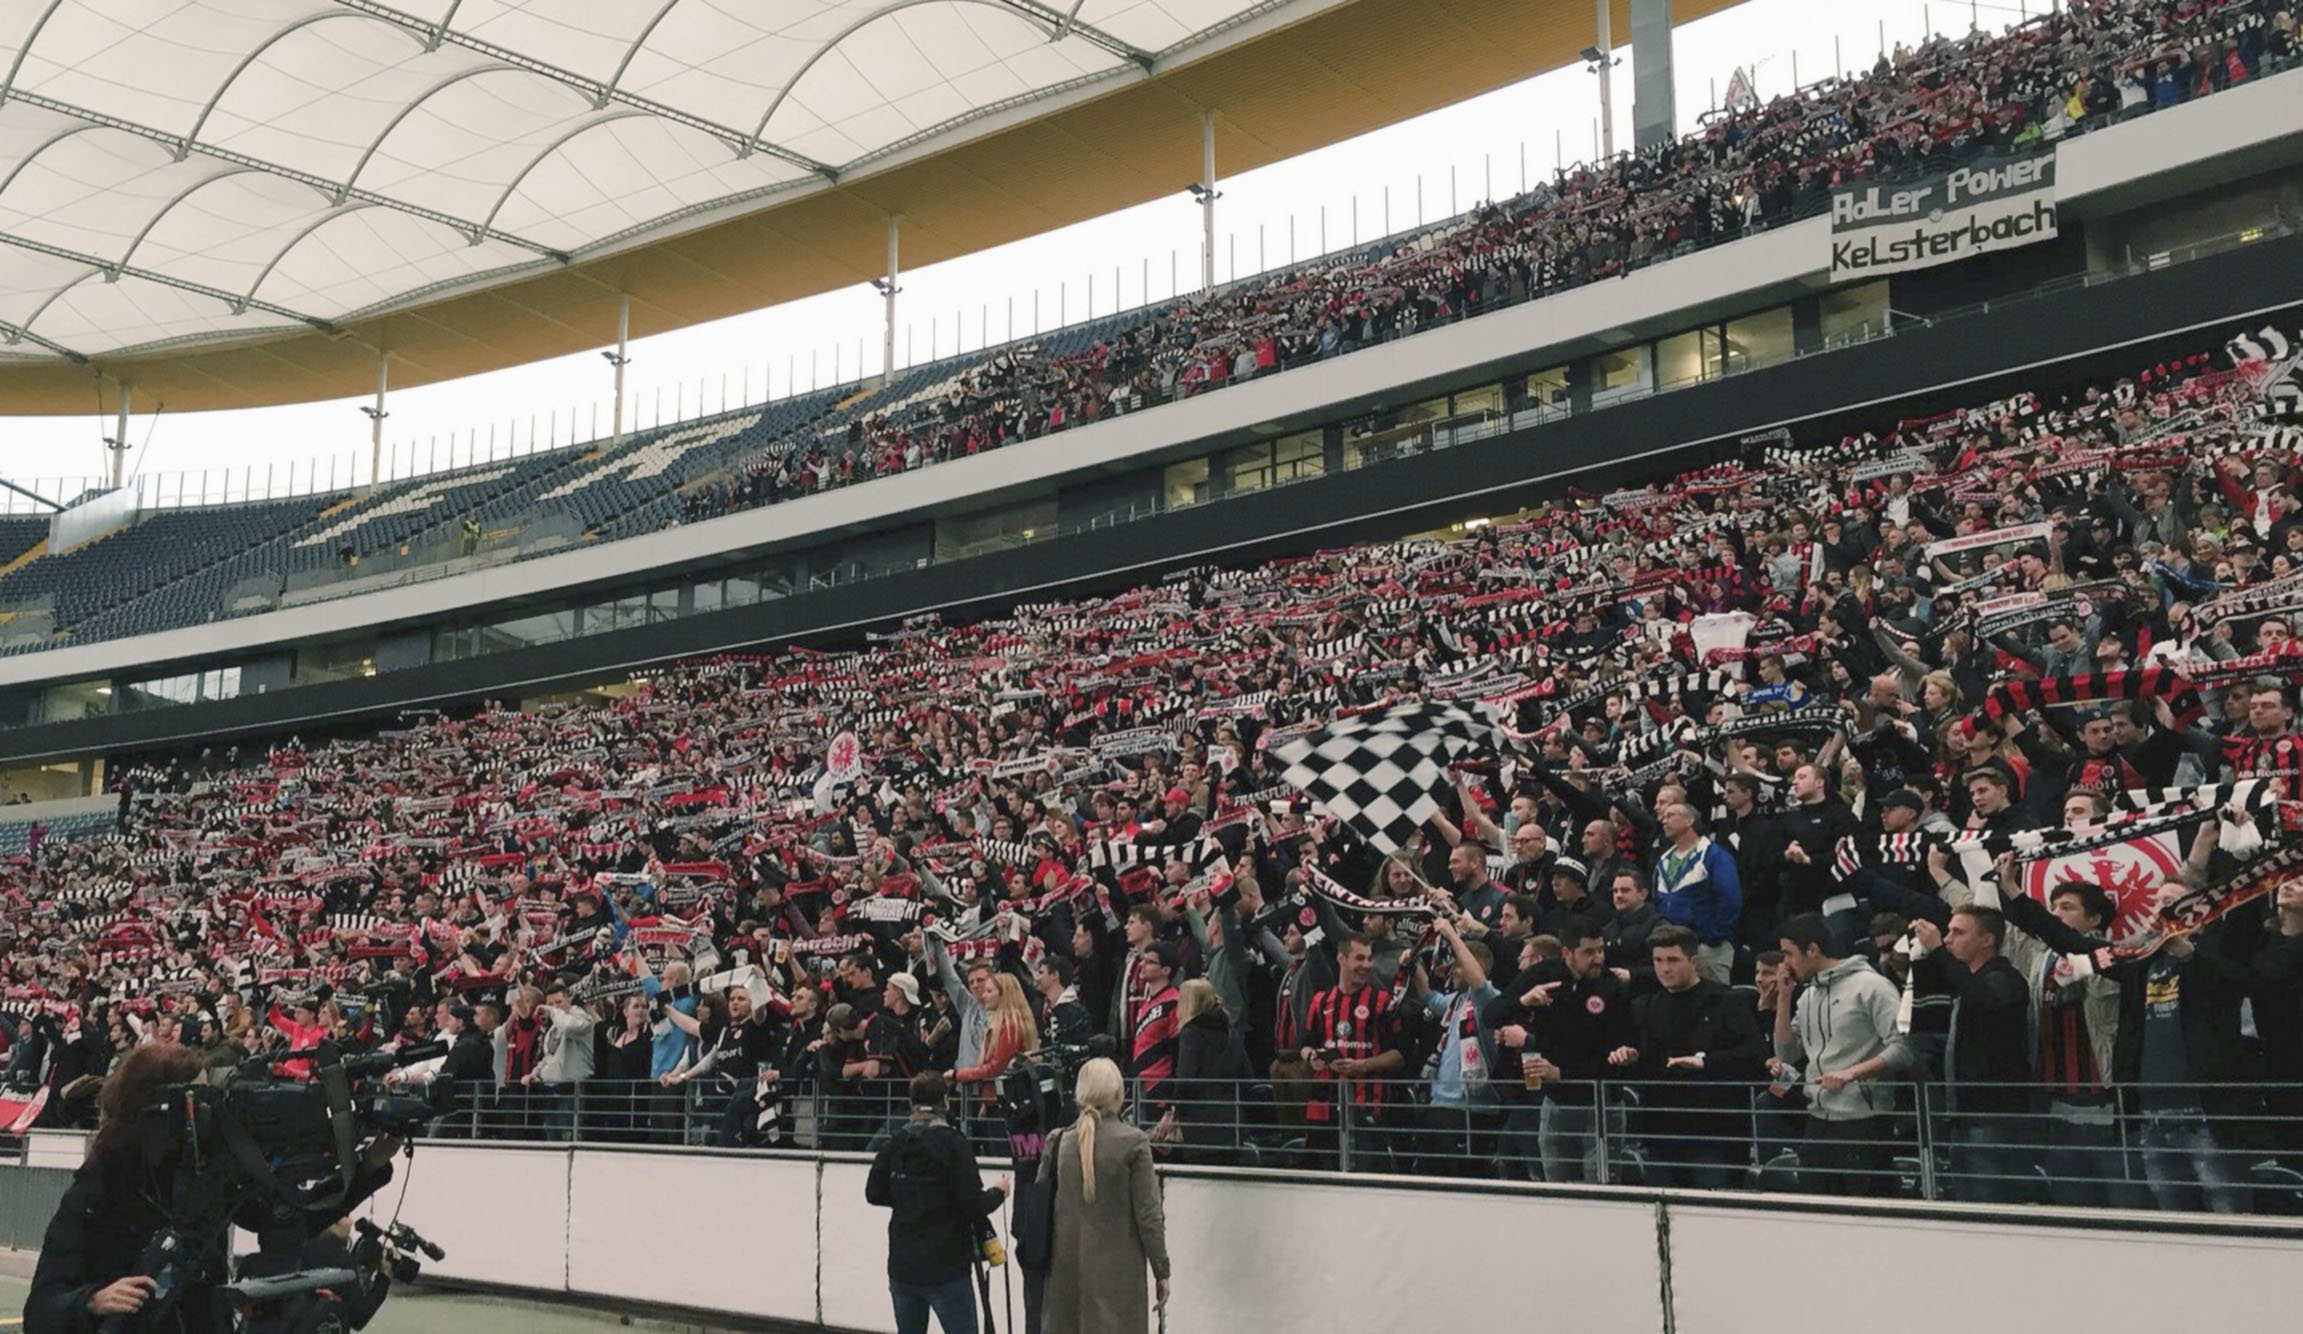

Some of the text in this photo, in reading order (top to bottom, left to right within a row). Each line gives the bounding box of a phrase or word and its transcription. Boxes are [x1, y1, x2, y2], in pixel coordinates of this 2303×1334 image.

[1947, 153, 2055, 203] Power
[2256, 767, 2299, 778] Romeo
[1313, 875, 1431, 909] EINTRACH
